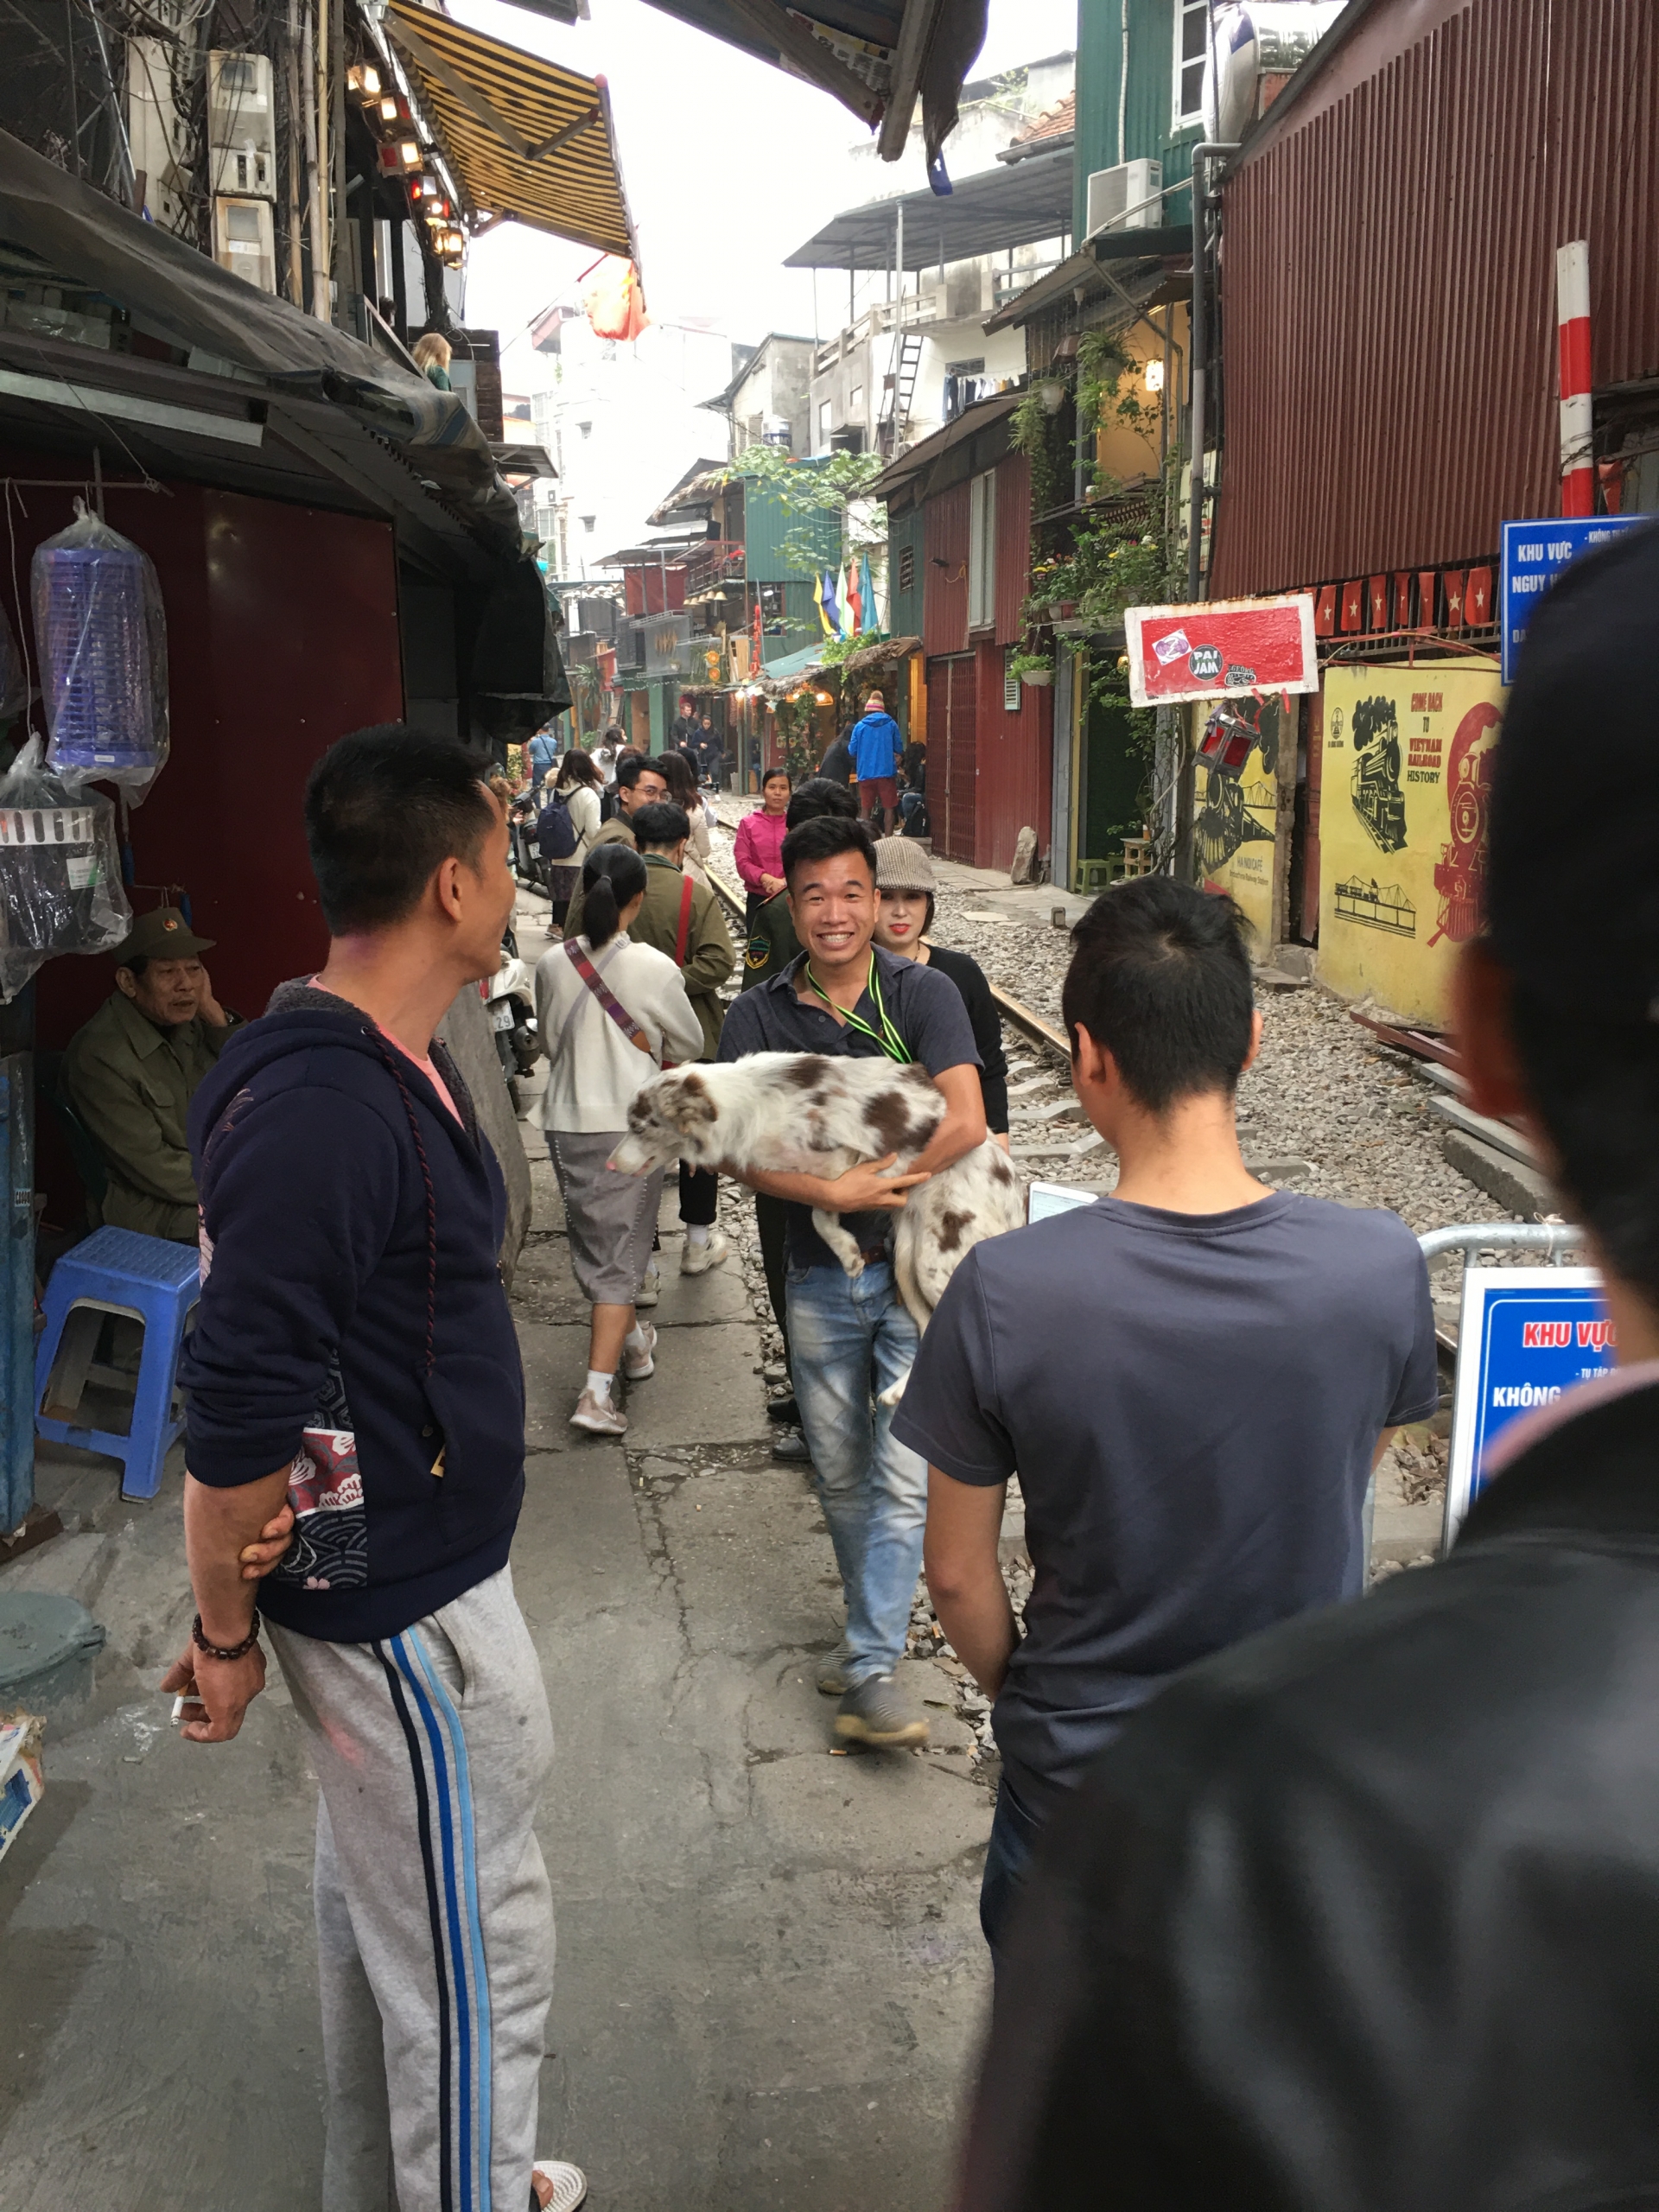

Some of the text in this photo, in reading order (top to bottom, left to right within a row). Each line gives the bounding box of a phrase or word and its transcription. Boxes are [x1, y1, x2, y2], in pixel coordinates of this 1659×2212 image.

[1518, 541, 1573, 563] KHU VỰC
[1512, 574, 1546, 594] NGUY
[1193, 650, 1218, 661] PAI
[1193, 661, 1219, 674] JAM
[1411, 692, 1443, 712] COME BACK
[1423, 716, 1430, 733] TO
[1409, 738, 1442, 753] VIETNAM
[1408, 753, 1441, 768] RAILROAD
[1407, 770, 1440, 784] HISTORY
[496, 1015, 511, 1028] 29
[1522, 1321, 1572, 1348] KHU
[1493, 1382, 1561, 1407] KHÔNG
